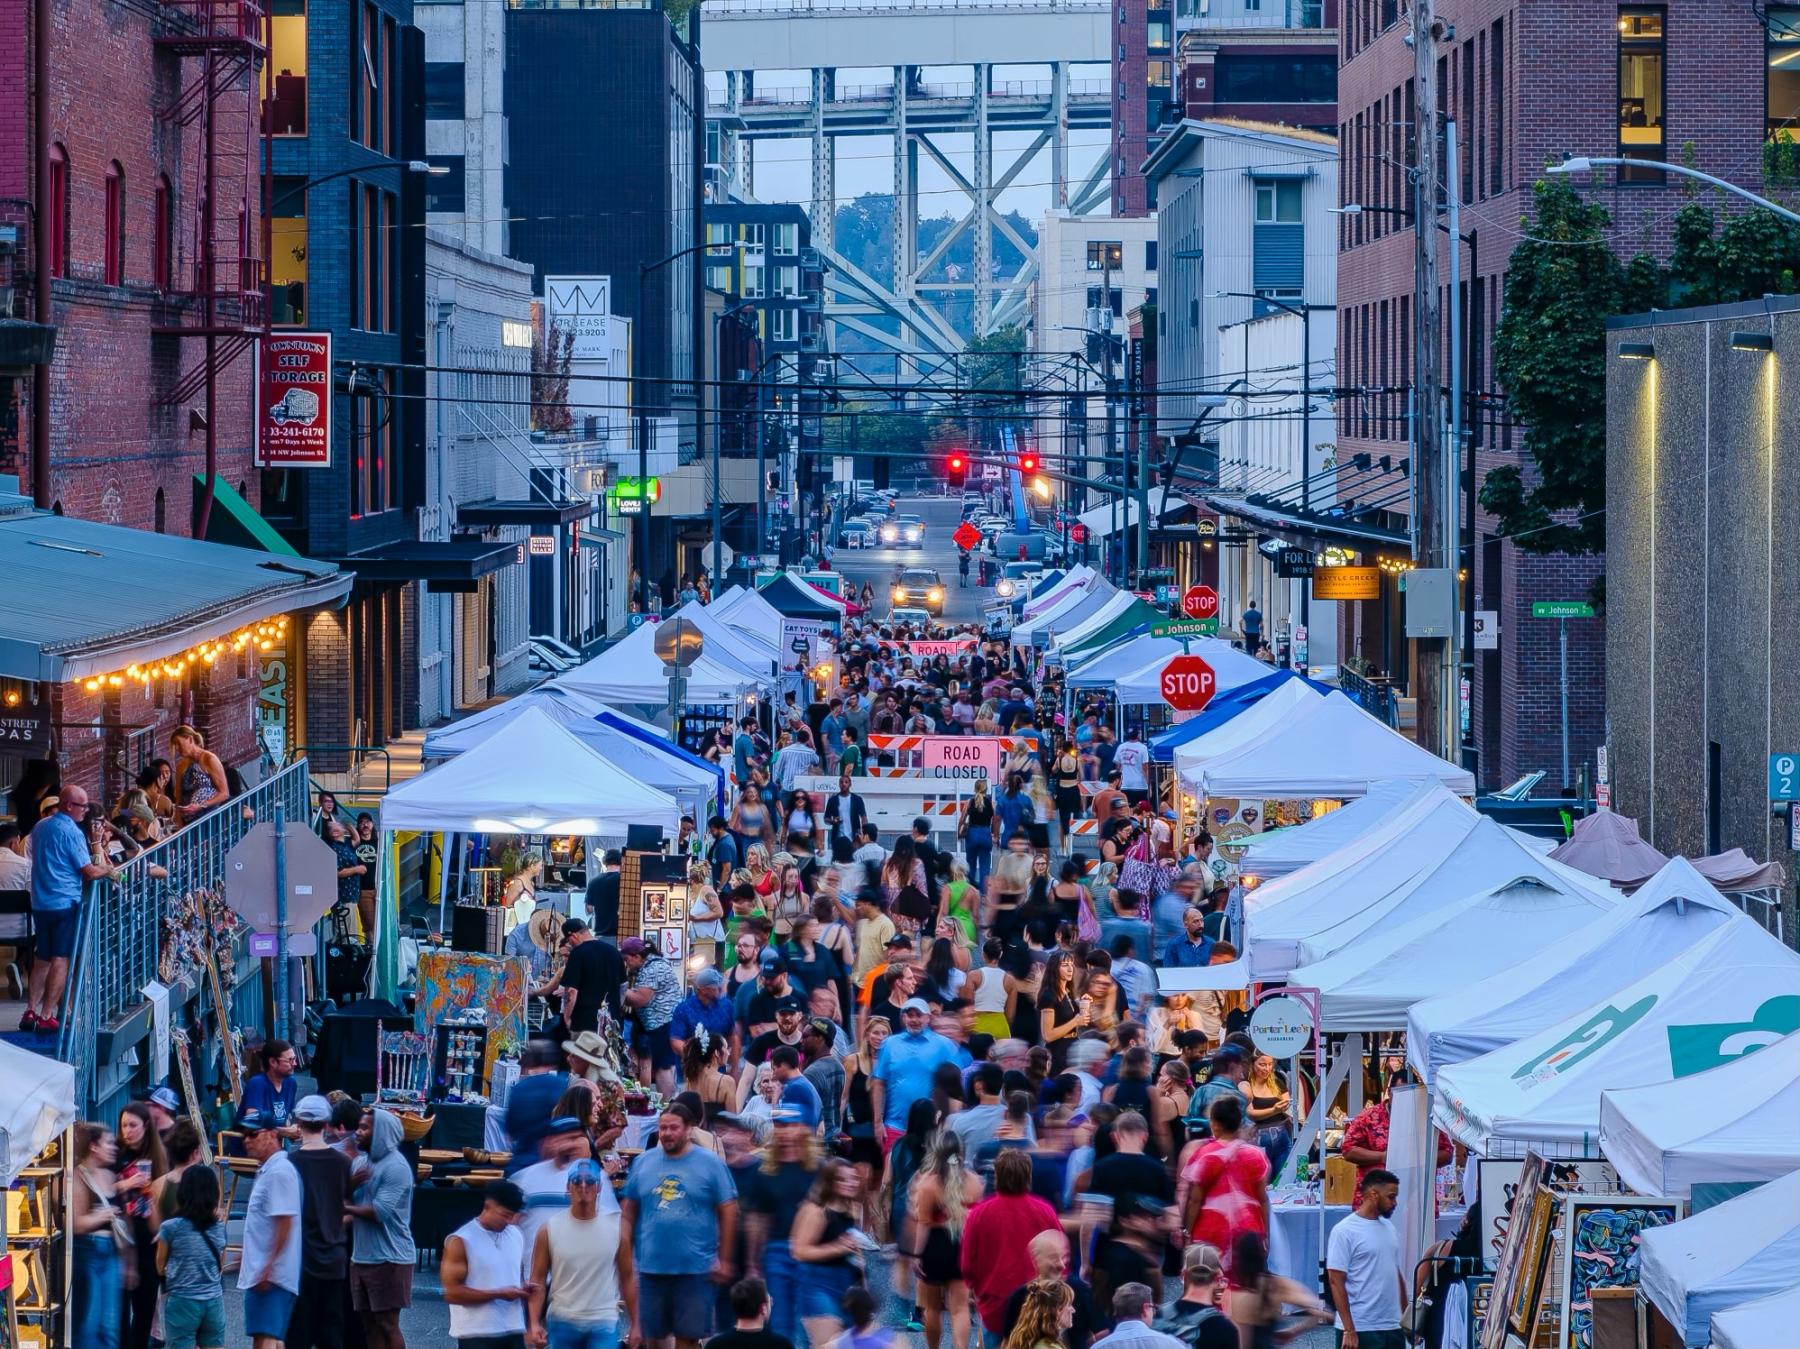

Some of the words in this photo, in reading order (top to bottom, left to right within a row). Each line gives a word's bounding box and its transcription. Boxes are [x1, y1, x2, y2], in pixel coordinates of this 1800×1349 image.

[263, 340, 325, 355] OWNTOWN
[279, 355, 309, 367] SELF
[262, 371, 325, 383] TORAGE
[1073, 531, 1085, 539] STO
[1284, 552, 1303, 564] FOR
[1186, 597, 1216, 610] STOP
[1549, 606, 1579, 615] Johnson
[800, 625, 818, 633] TOYS
[1167, 623, 1207, 635] Johnson
[918, 646, 947, 656] ROAD
[1164, 673, 1213, 695] STOP
[943, 746, 981, 760] ROAD
[1781, 759, 1791, 772] P
[934, 765, 988, 779] CLOSED
[1780, 777, 1792, 794] 2
